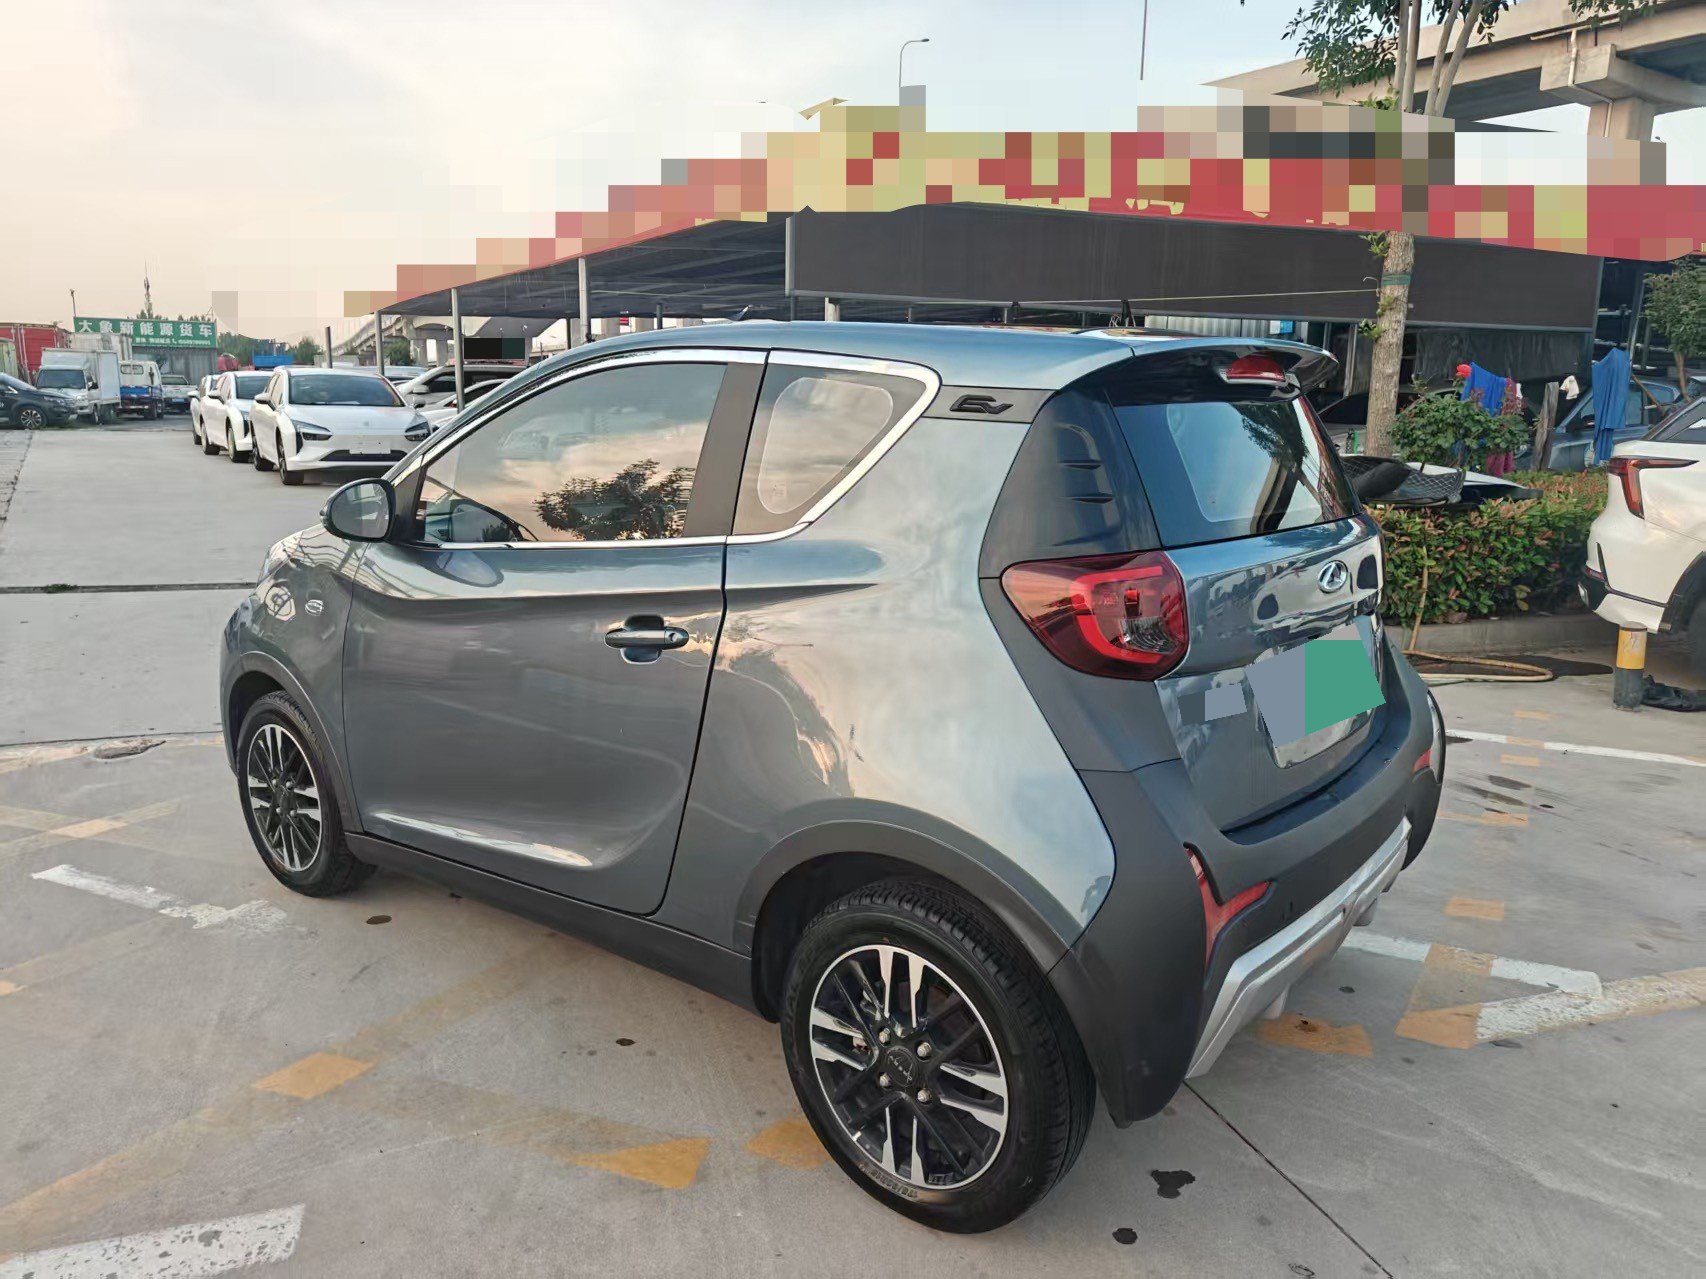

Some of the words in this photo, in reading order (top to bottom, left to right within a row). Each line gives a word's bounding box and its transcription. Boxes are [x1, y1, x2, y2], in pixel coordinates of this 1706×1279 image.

[79, 320, 213, 337] 大象新能源货车
